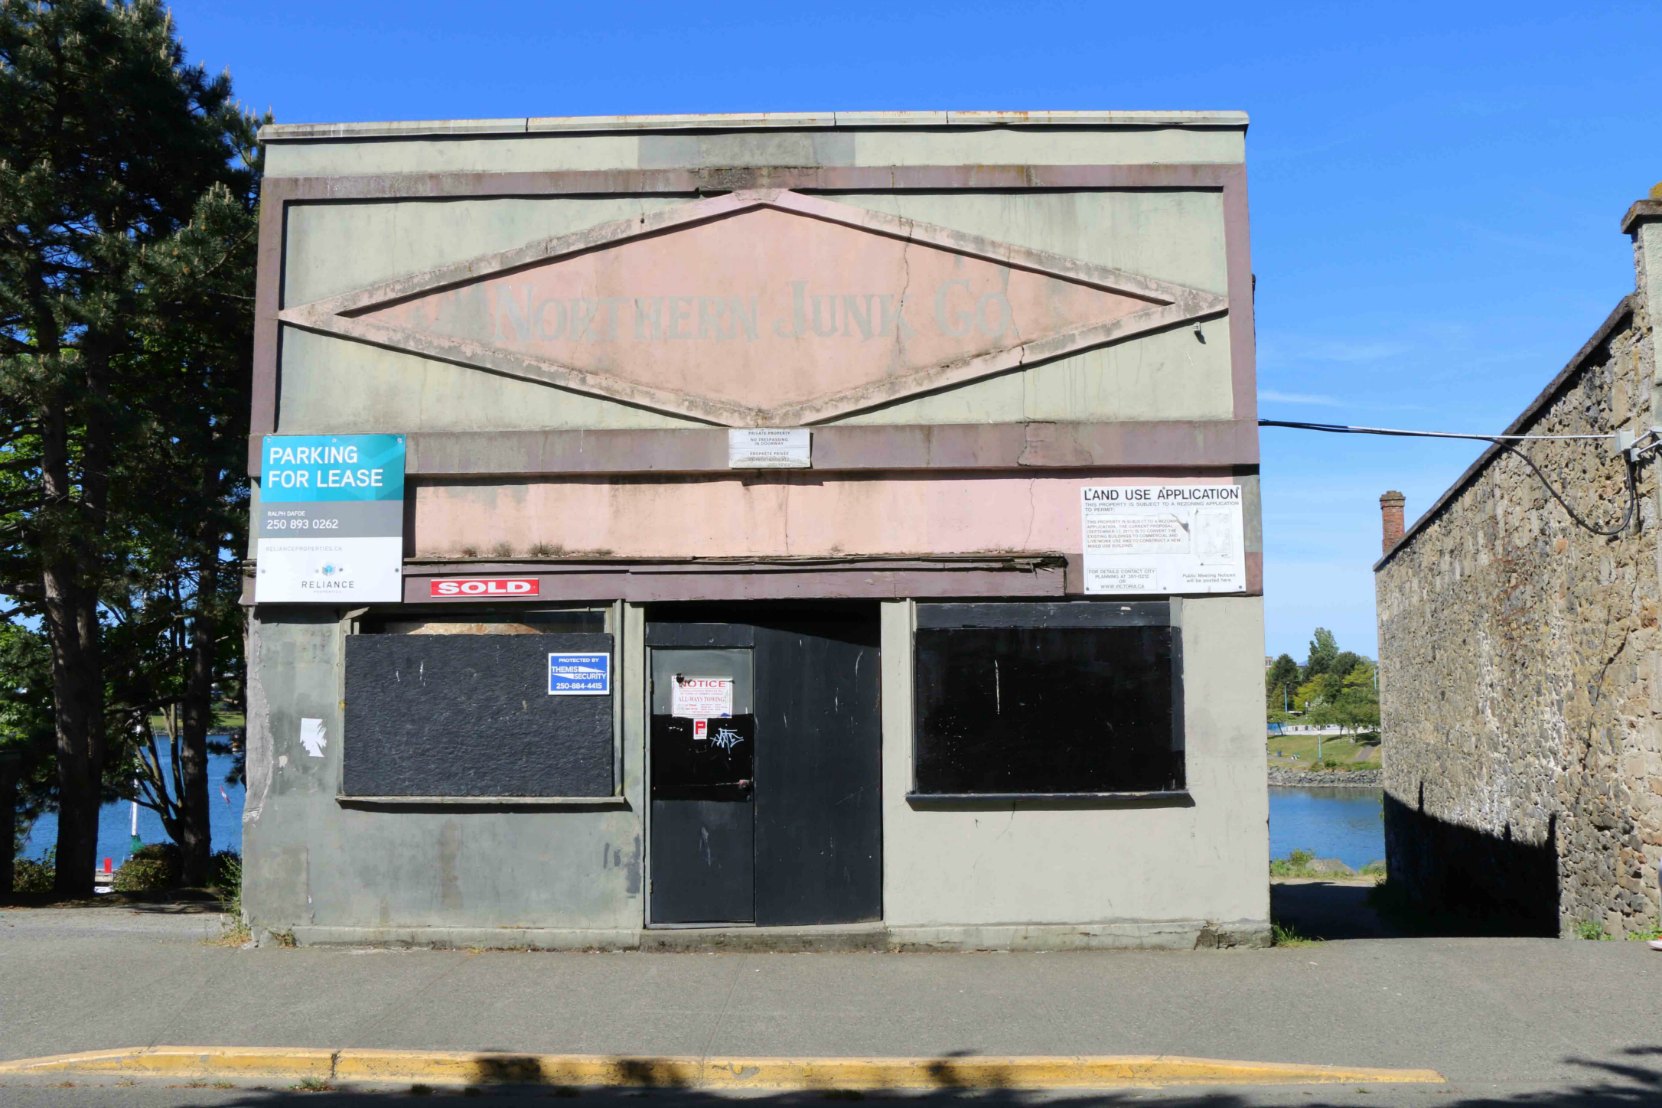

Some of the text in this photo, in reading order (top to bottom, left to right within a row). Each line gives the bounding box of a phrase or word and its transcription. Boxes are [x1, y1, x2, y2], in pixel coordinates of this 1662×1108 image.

[269, 445, 358, 465] PARKING
[268, 468, 383, 488] FOR LEASE
[1084, 488, 1239, 501] LAND USE APPLICATION
[266, 519, 339, 530] 250 893 0262
[301, 580, 355, 589] RELIANCE
[438, 581, 532, 594] SOLD
[679, 680, 726, 688] NOTICE
